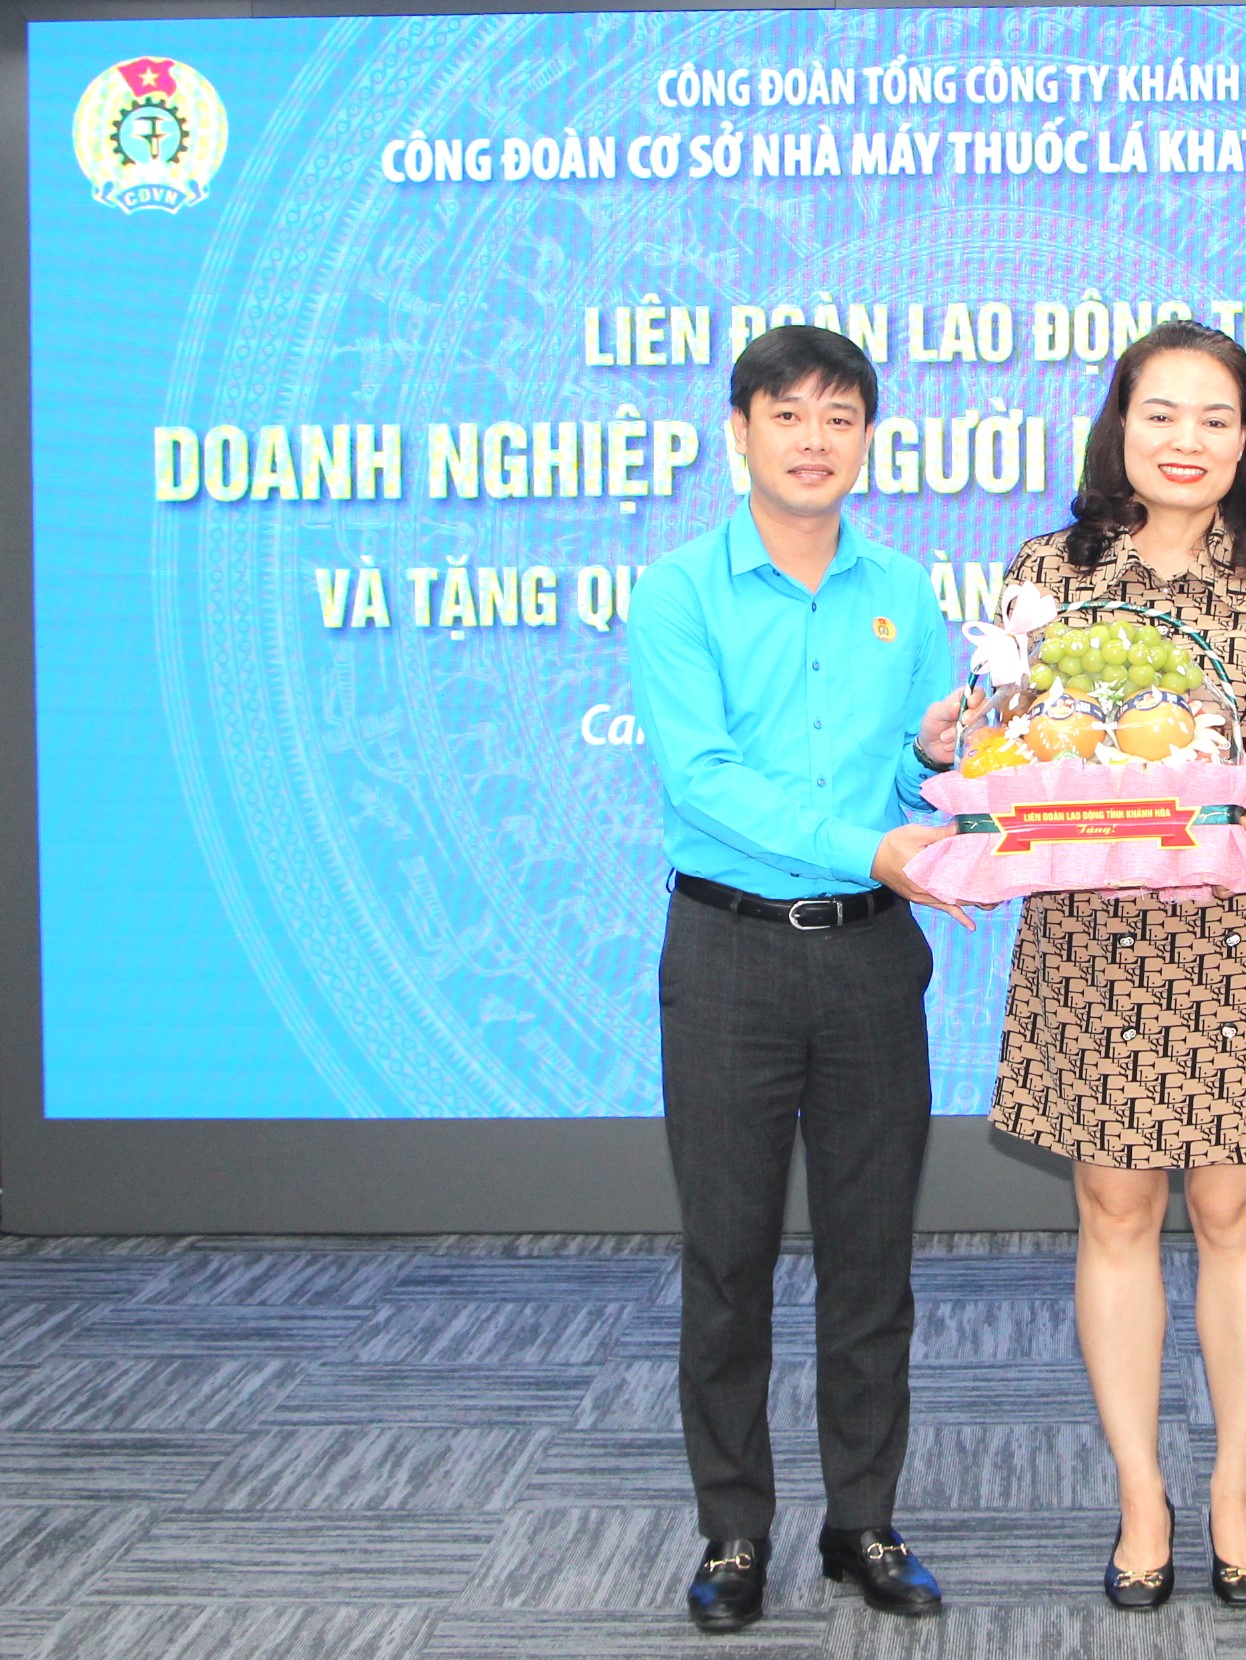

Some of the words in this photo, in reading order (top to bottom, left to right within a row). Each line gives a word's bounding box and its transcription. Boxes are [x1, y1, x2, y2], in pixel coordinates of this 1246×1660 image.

[659, 67, 747, 107] CÔNG
[758, 64, 854, 107] ĐOÀN
[863, 54, 957, 105] TỔNG
[965, 56, 1059, 104] CÔNG
[1064, 63, 1107, 103] TY
[1117, 58, 1240, 102] KHÁNH
[382, 131, 493, 184] CÔNG
[500, 131, 615, 182] ĐOÀN
[627, 133, 682, 180] CƠ
[690, 122, 744, 178] SỞ
[753, 124, 843, 177] NHÀ
[852, 123, 938, 176] MÁY
[948, 116, 1088, 176] THUỐC
[1098, 121, 1148, 175] LÁ
[584, 293, 710, 368] LIÊN
[908, 302, 1014, 362] LAO
[154, 423, 402, 501] DOANH
[428, 403, 700, 514] NGHIỆP
[850, 397, 1046, 494] GƯỜI
[315, 555, 390, 630] VÀ
[407, 554, 558, 640] TẶNG
[581, 703, 645, 746] Ca
[1023, 812, 1041, 822] LIÊN
[1066, 812, 1081, 820] LAO
